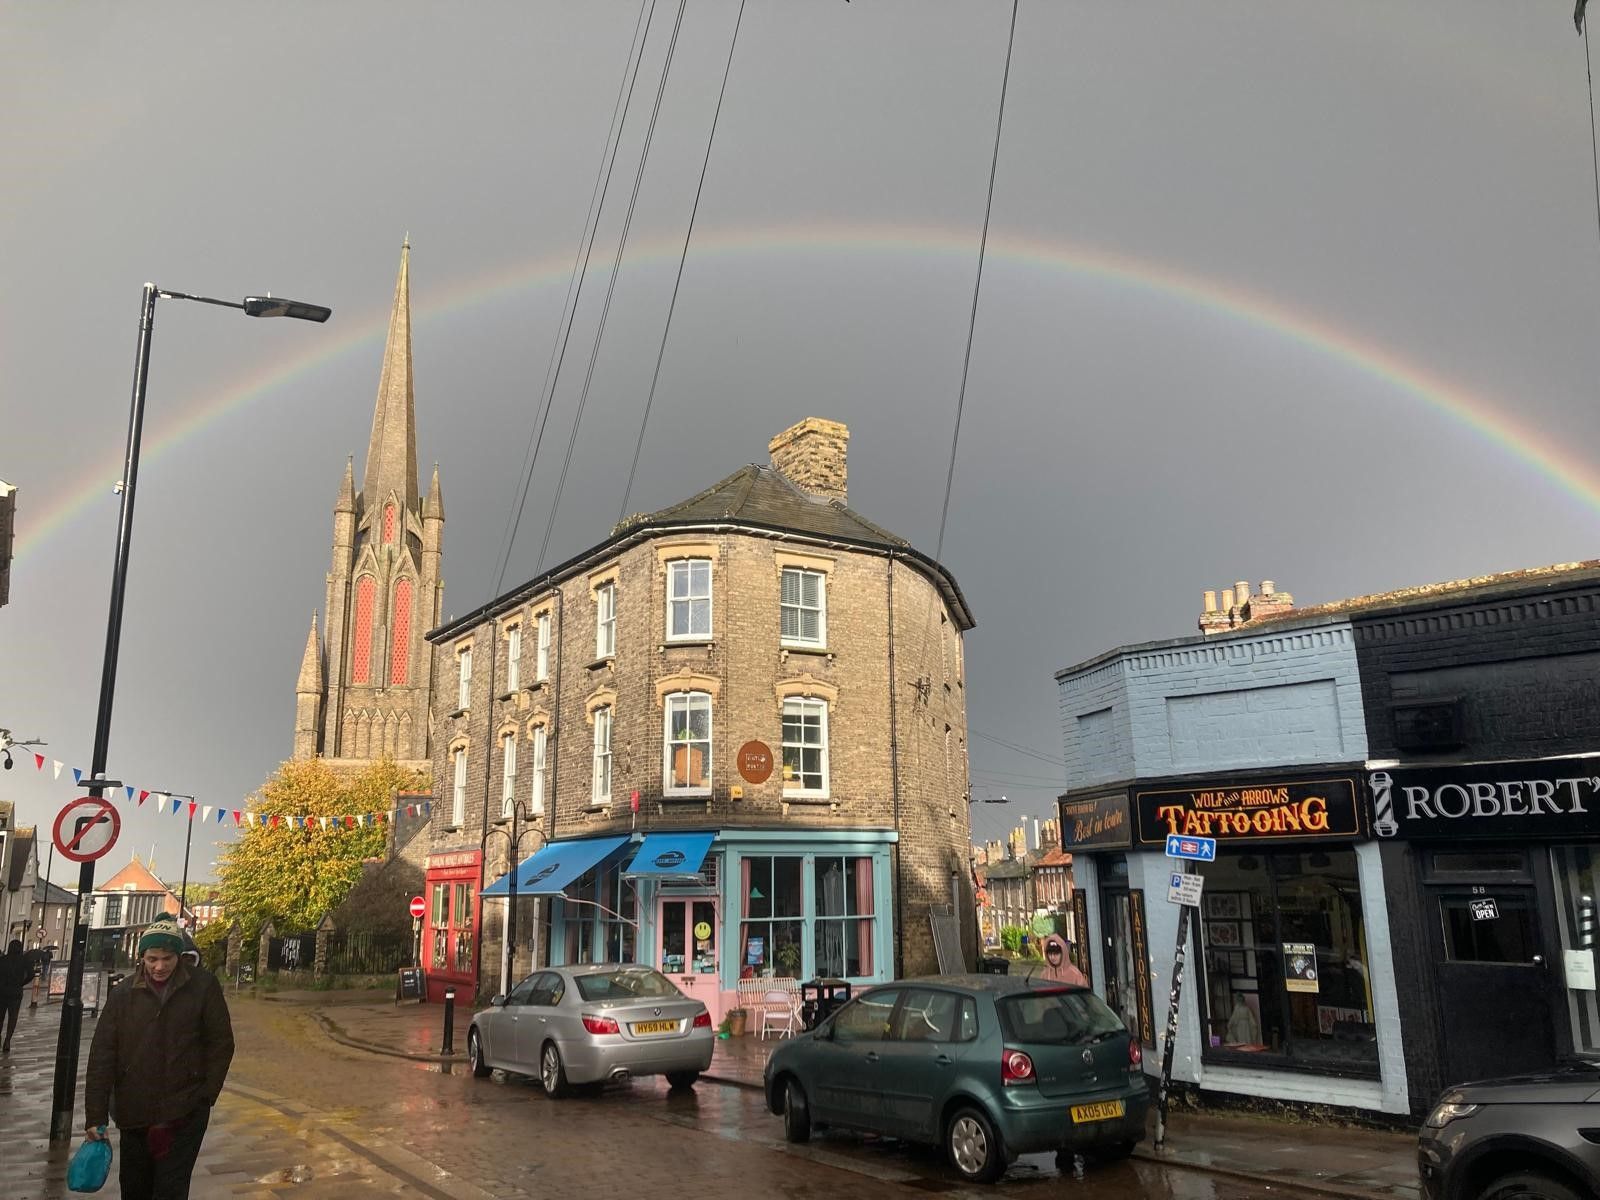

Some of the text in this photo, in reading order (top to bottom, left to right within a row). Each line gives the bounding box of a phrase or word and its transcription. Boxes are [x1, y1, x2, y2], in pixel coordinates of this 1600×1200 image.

[1192, 787, 1290, 808] WOLF AND ARROWS
[1157, 797, 1330, 835] TATTOOING
[1173, 876, 1180, 887] P
[1472, 886, 1486, 894] 58
[1475, 909, 1495, 919] OPEN
[1131, 893, 1151, 1041] TATTOOING
[1076, 1103, 1118, 1120] AX05 UGY
